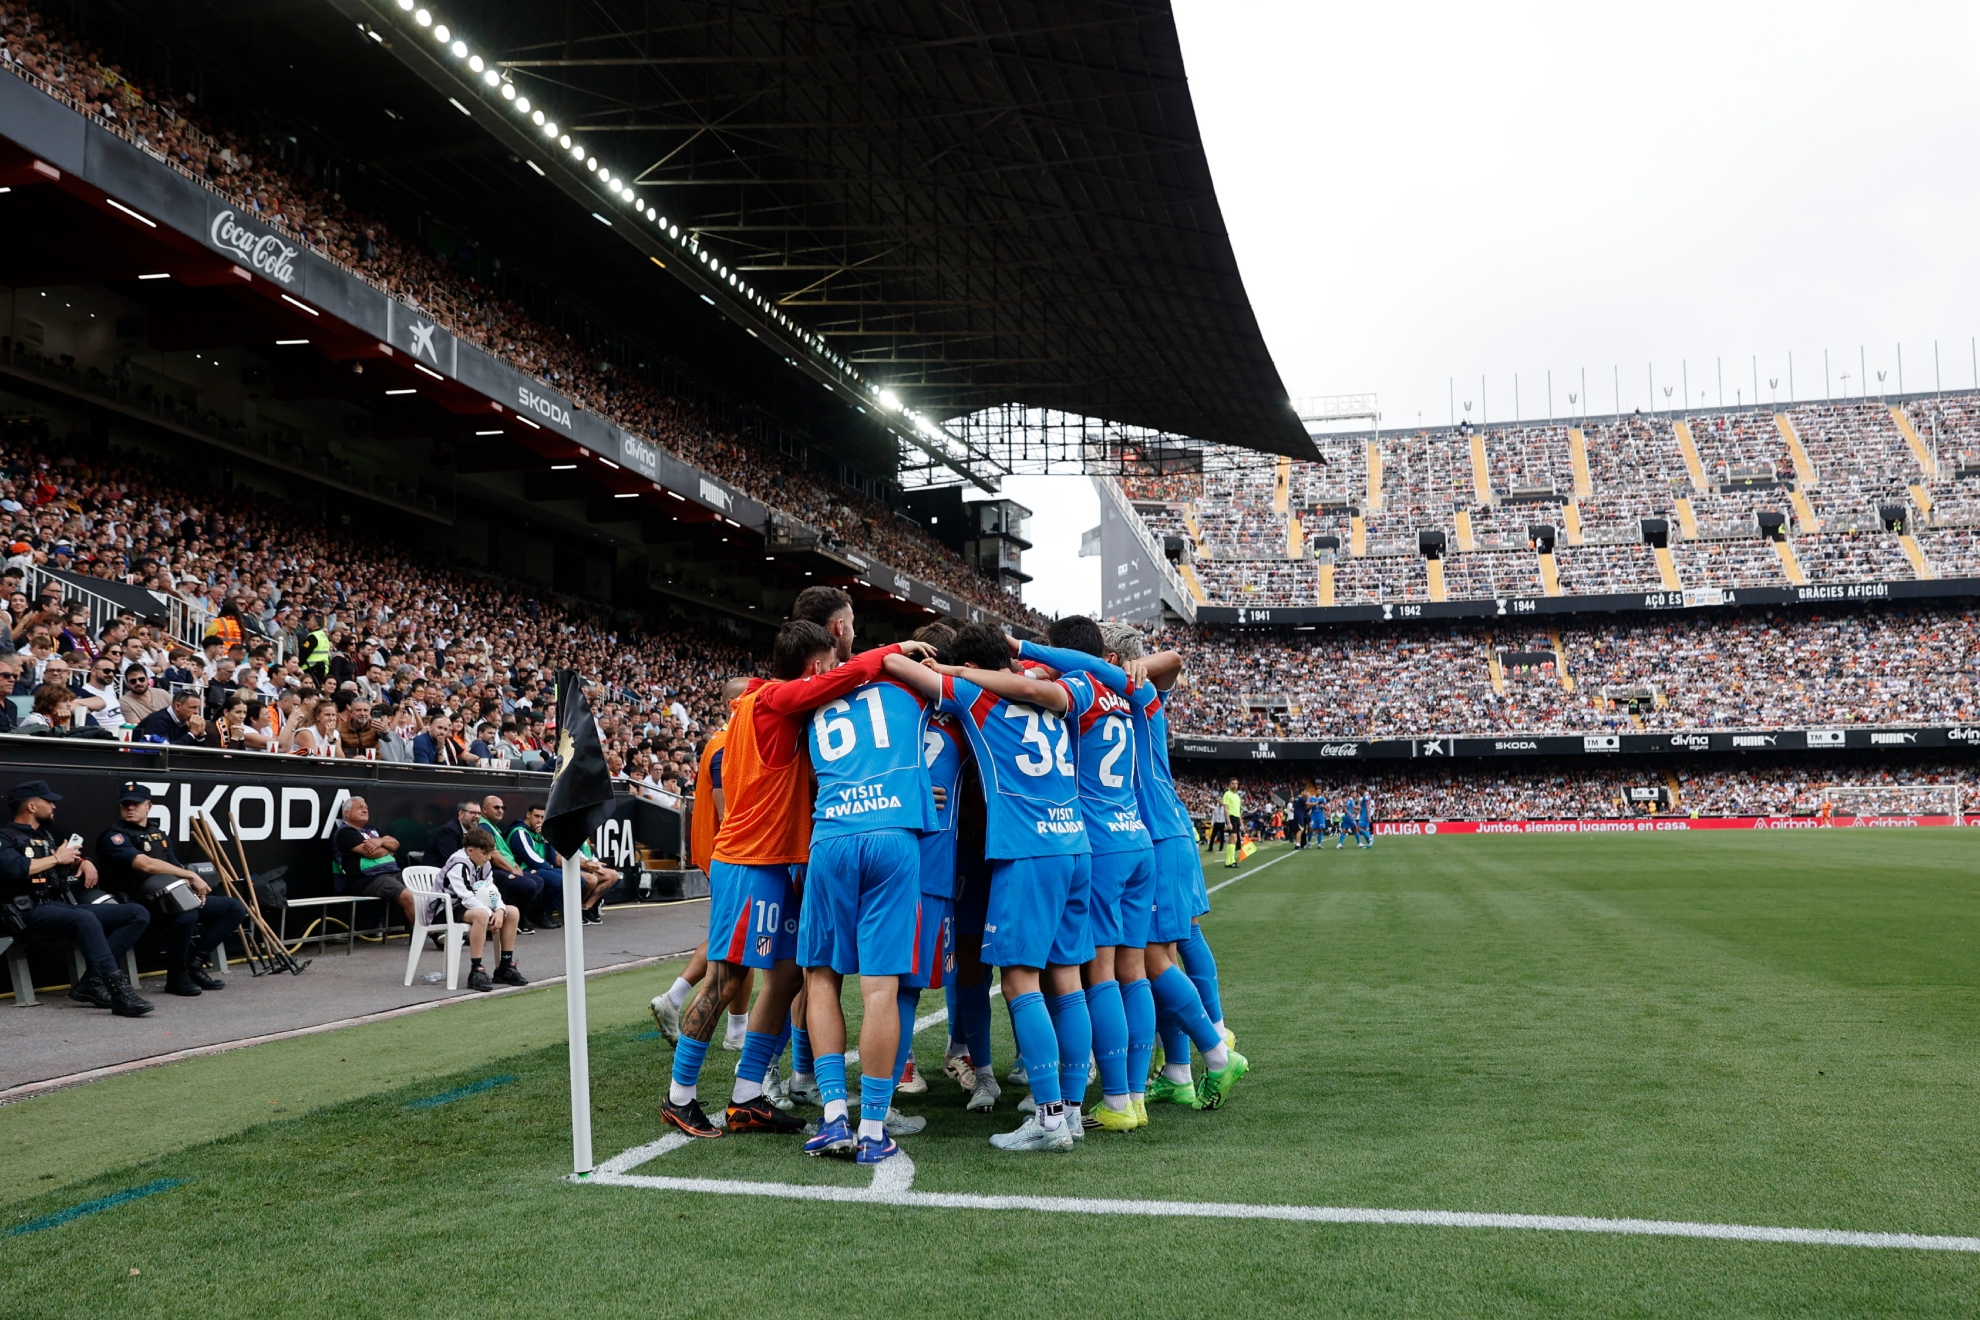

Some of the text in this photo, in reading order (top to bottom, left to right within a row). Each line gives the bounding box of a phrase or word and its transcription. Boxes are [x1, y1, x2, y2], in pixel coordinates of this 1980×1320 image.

[211, 210, 299, 284] Coca-Cola
[518, 386, 572, 430] SKODA
[624, 436, 656, 468] divina
[699, 478, 726, 510] PUMA
[1798, 583, 1889, 599] GRÀCIES AFICIÓ!
[1399, 605, 1421, 616] 1942
[1513, 600, 1536, 612] 1944
[1250, 610, 1270, 621] 1941
[813, 686, 890, 762] 61
[1004, 704, 1075, 777] 32
[1671, 734, 1709, 746] divina
[1871, 732, 1905, 745] PUMA
[1948, 727, 1980, 740] divin
[1495, 741, 1537, 750] SKODA
[1732, 735, 1766, 747] PUMA
[1184, 745, 1217, 753] MARTINELLI
[1251, 750, 1276, 759] TURIA
[1320, 743, 1359, 757] Coca-Cola
[839, 783, 883, 801] VISIT
[825, 795, 902, 819] RWANDA
[1047, 807, 1074, 821] VISIT
[1375, 823, 1422, 836] LALIGA
[1476, 822, 1523, 833] Juntos,
[1525, 821, 1577, 833] siempre
[1637, 822, 1654, 831] en
[1656, 821, 1690, 831] casa.
[1770, 818, 1818, 829] airbnb
[1869, 817, 1918, 827] airbnb
[755, 900, 780, 933] 10
